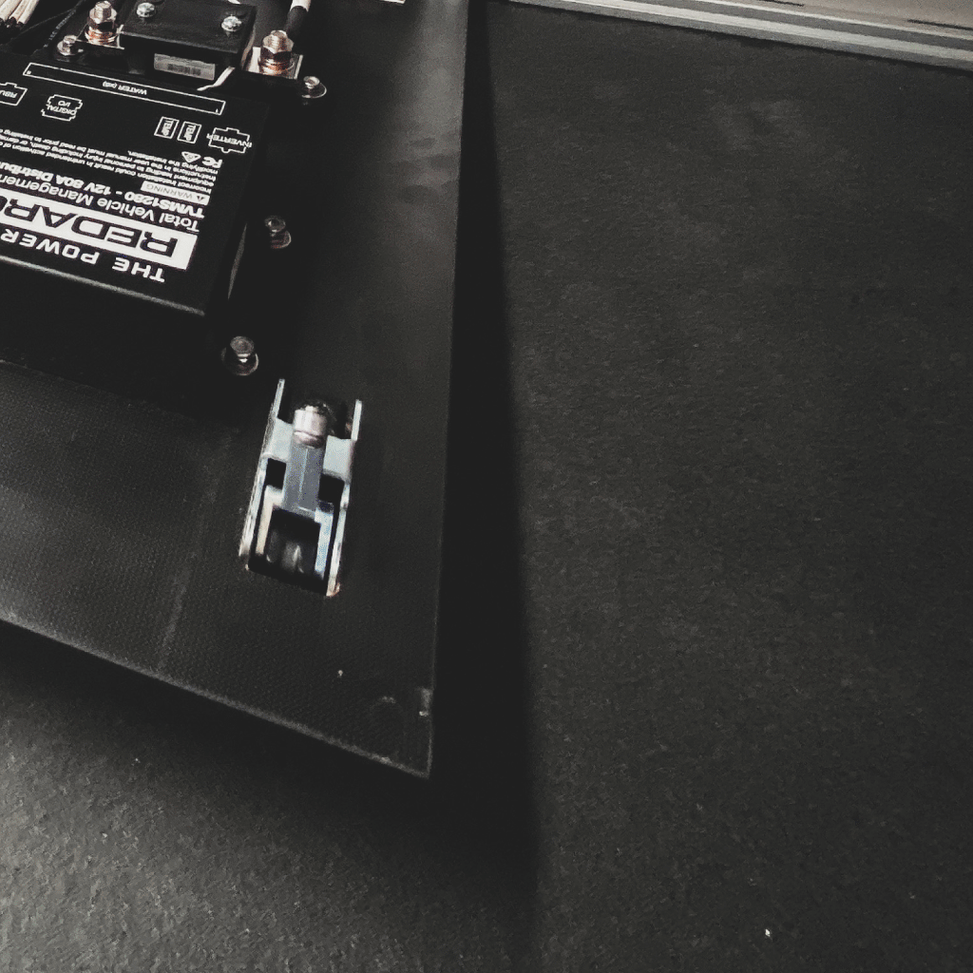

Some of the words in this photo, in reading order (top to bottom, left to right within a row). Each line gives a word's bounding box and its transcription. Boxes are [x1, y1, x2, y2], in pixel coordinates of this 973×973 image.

[117, 84, 146, 95] WATER
[42, 103, 77, 115] DIGITAL
[29, 141, 50, 150] death,
[205, 133, 252, 147] INVERTER
[11, 144, 45, 155] activation
[50, 145, 83, 157] including
[86, 147, 105, 155] must
[45, 151, 85, 164] unintended
[83, 152, 103, 162] injury
[105, 152, 132, 161] manual
[93, 162, 114, 171] result
[103, 158, 136, 169] personal
[181, 161, 218, 174] modifying
[114, 167, 136, 176] could
[145, 166, 172, 178] leading
[55, 174, 84, 188] 80A
[136, 172, 176, 186] installation
[173, 173, 214, 186] equipment
[83, 182, 111, 195] 12V
[146, 183, 192, 198] WARNING
[177, 181, 211, 194] Incorrect
[96, 197, 154, 221] Vehicle
[124, 191, 204, 218] TVMS1280
[158, 212, 199, 232] Total
[0, 228, 99, 264] POWER
[111, 256, 164, 282] THE
